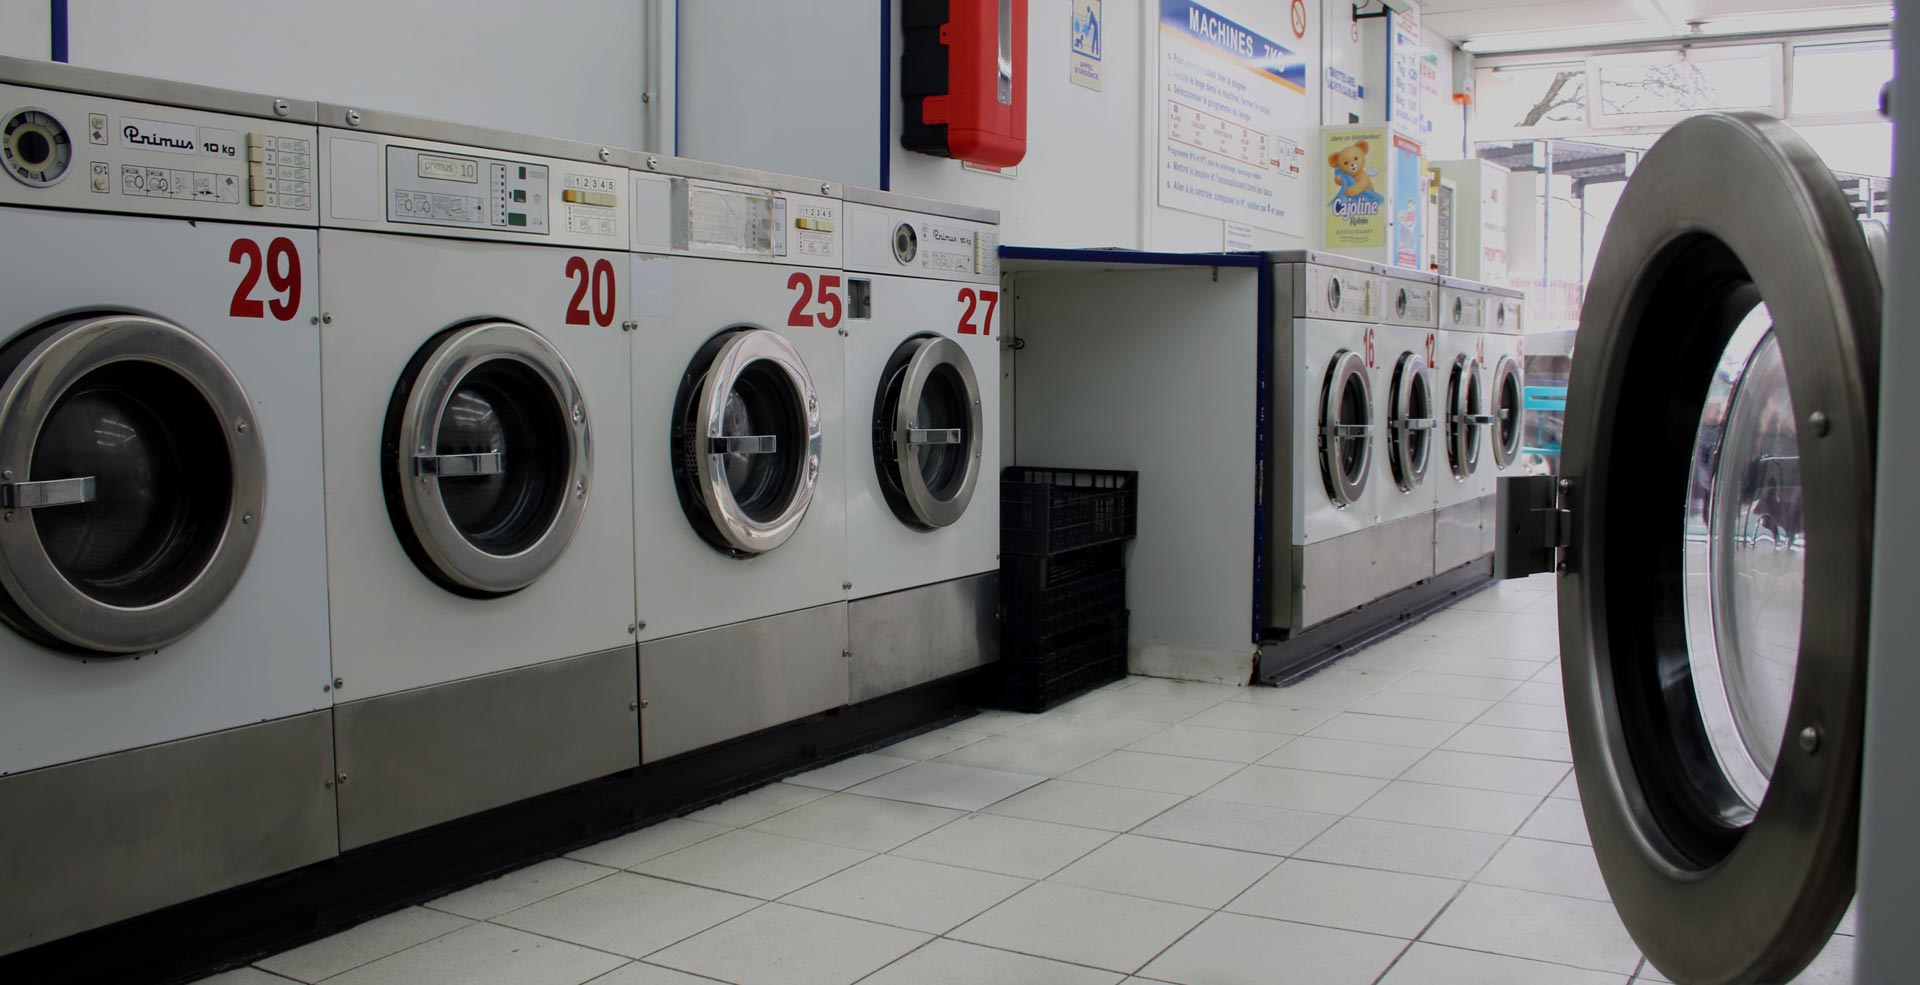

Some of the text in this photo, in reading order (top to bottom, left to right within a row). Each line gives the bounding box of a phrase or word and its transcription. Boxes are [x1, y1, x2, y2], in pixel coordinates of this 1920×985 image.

[1189, 7, 1254, 58] MACHINES
[123, 125, 236, 157] Primus 10 kg
[267, 139, 272, 147] 1
[267, 168, 273, 176] 3
[460, 164, 474, 178] 10
[576, 177, 614, 190] 1 2 3 4 5
[1333, 197, 1379, 221] Cajoline
[933, 229, 958, 242] Primus
[229, 237, 302, 321] 29
[565, 256, 616, 327] 20
[787, 272, 842, 329] 25
[957, 287, 998, 336] 27
[1363, 327, 1375, 369] 16
[1426, 333, 1435, 369] 12
